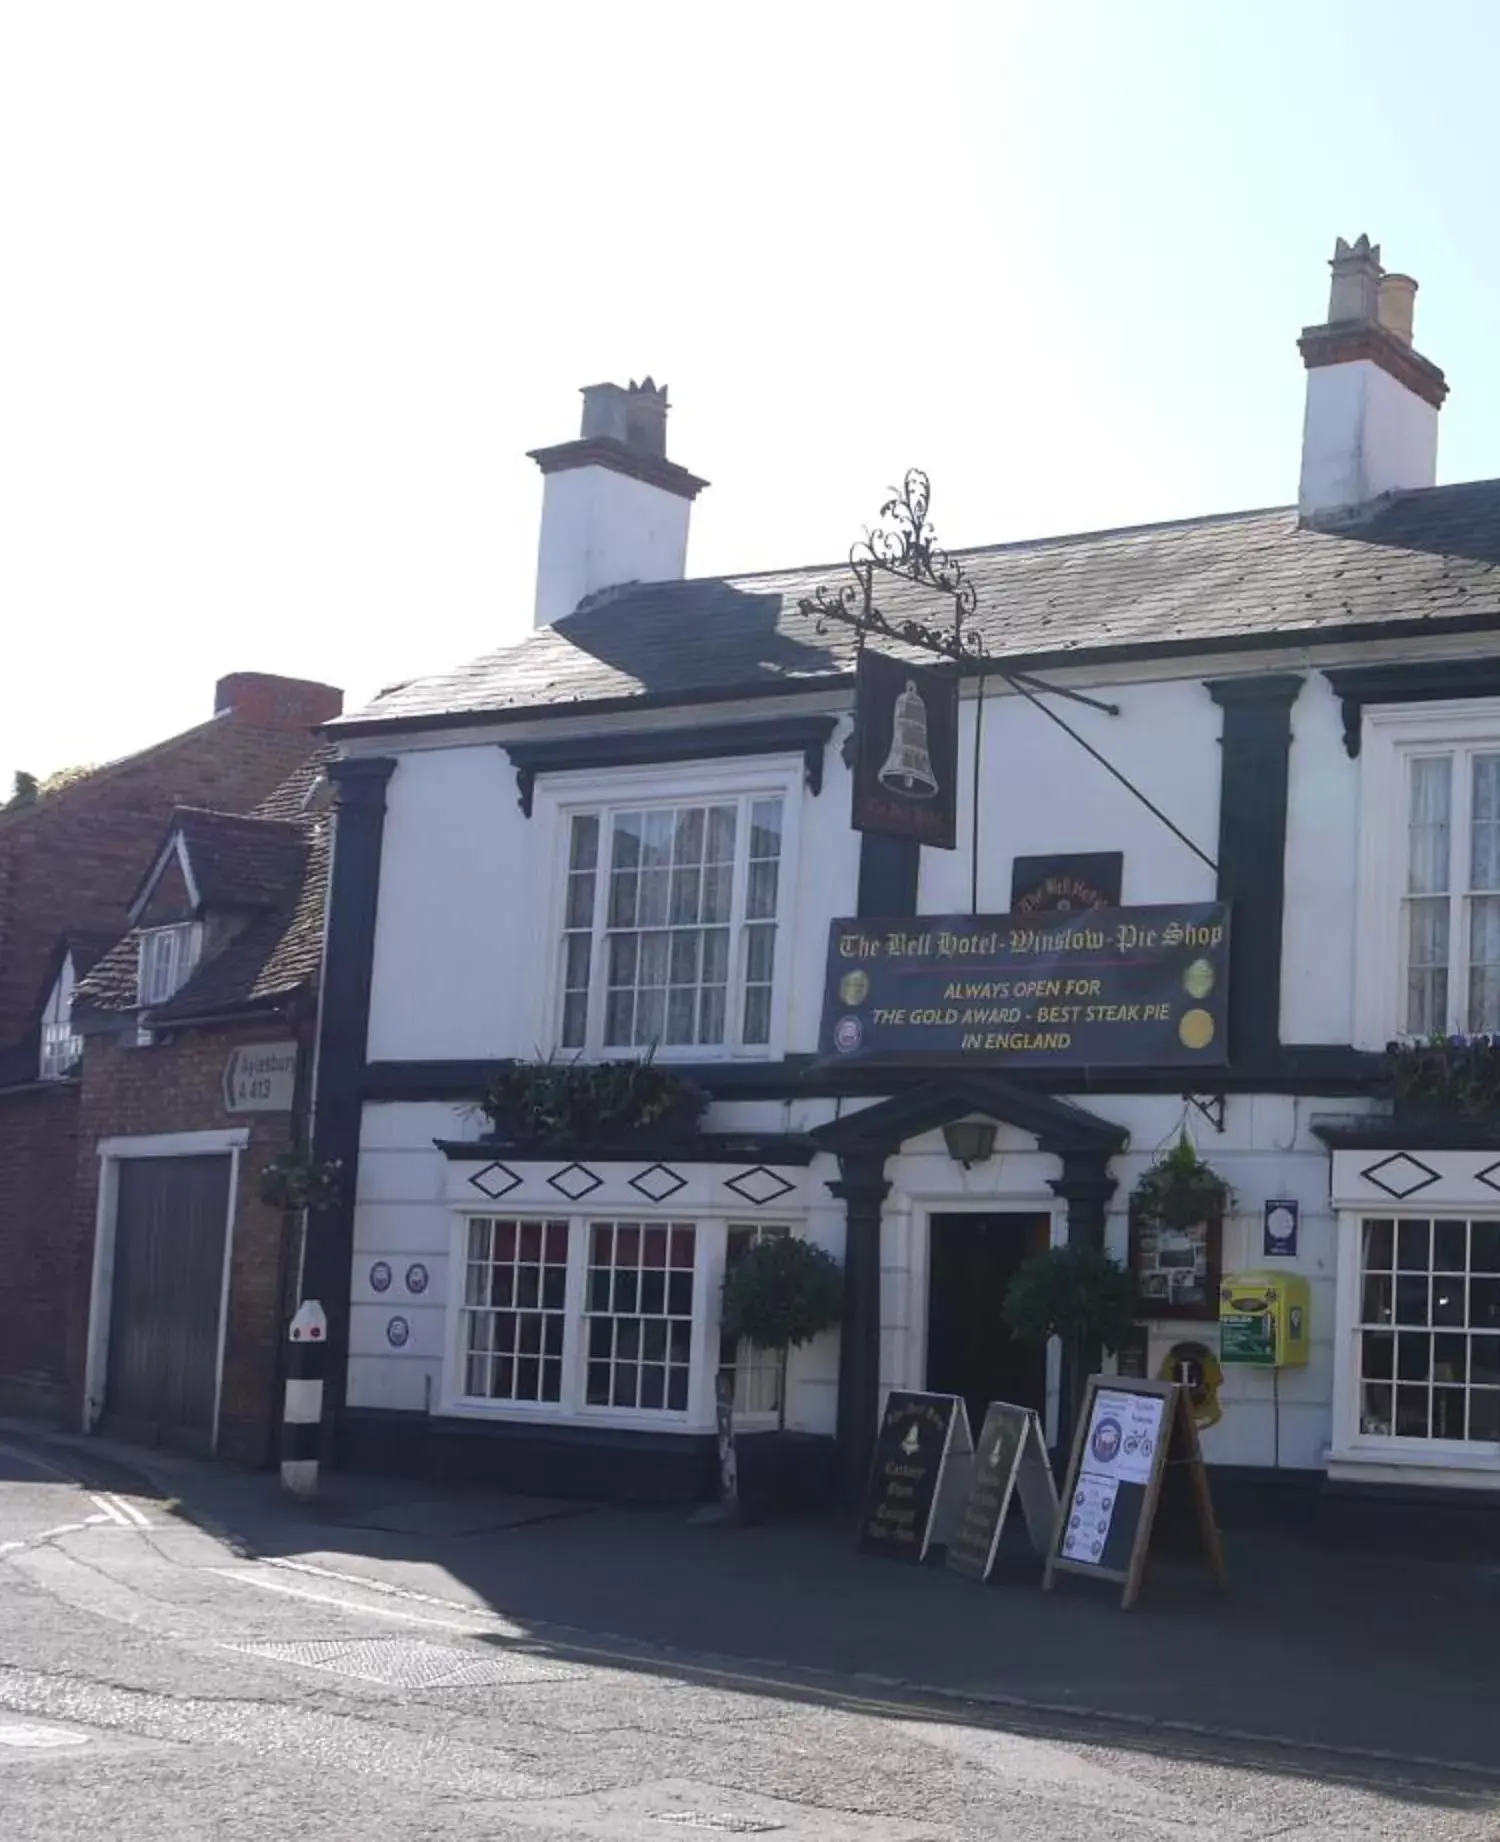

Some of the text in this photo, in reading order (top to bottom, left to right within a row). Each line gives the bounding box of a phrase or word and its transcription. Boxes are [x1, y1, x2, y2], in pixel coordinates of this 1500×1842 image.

[839, 933, 880, 959] The
[886, 932, 931, 957] Bell
[1161, 920, 1224, 950] Shop
[943, 978, 1102, 1000] ALWAYS OPEN FOR
[873, 1008, 907, 1025] THE
[910, 1007, 958, 1026] GOLD
[961, 1006, 1021, 1026] AWARD
[1036, 1005, 1081, 1024] BEST
[1086, 1003, 1139, 1022] STEAK
[1143, 1002, 1172, 1021] PIE
[961, 1031, 1073, 1051] IN ENGLAND
[238, 1078, 272, 1100] A 413
